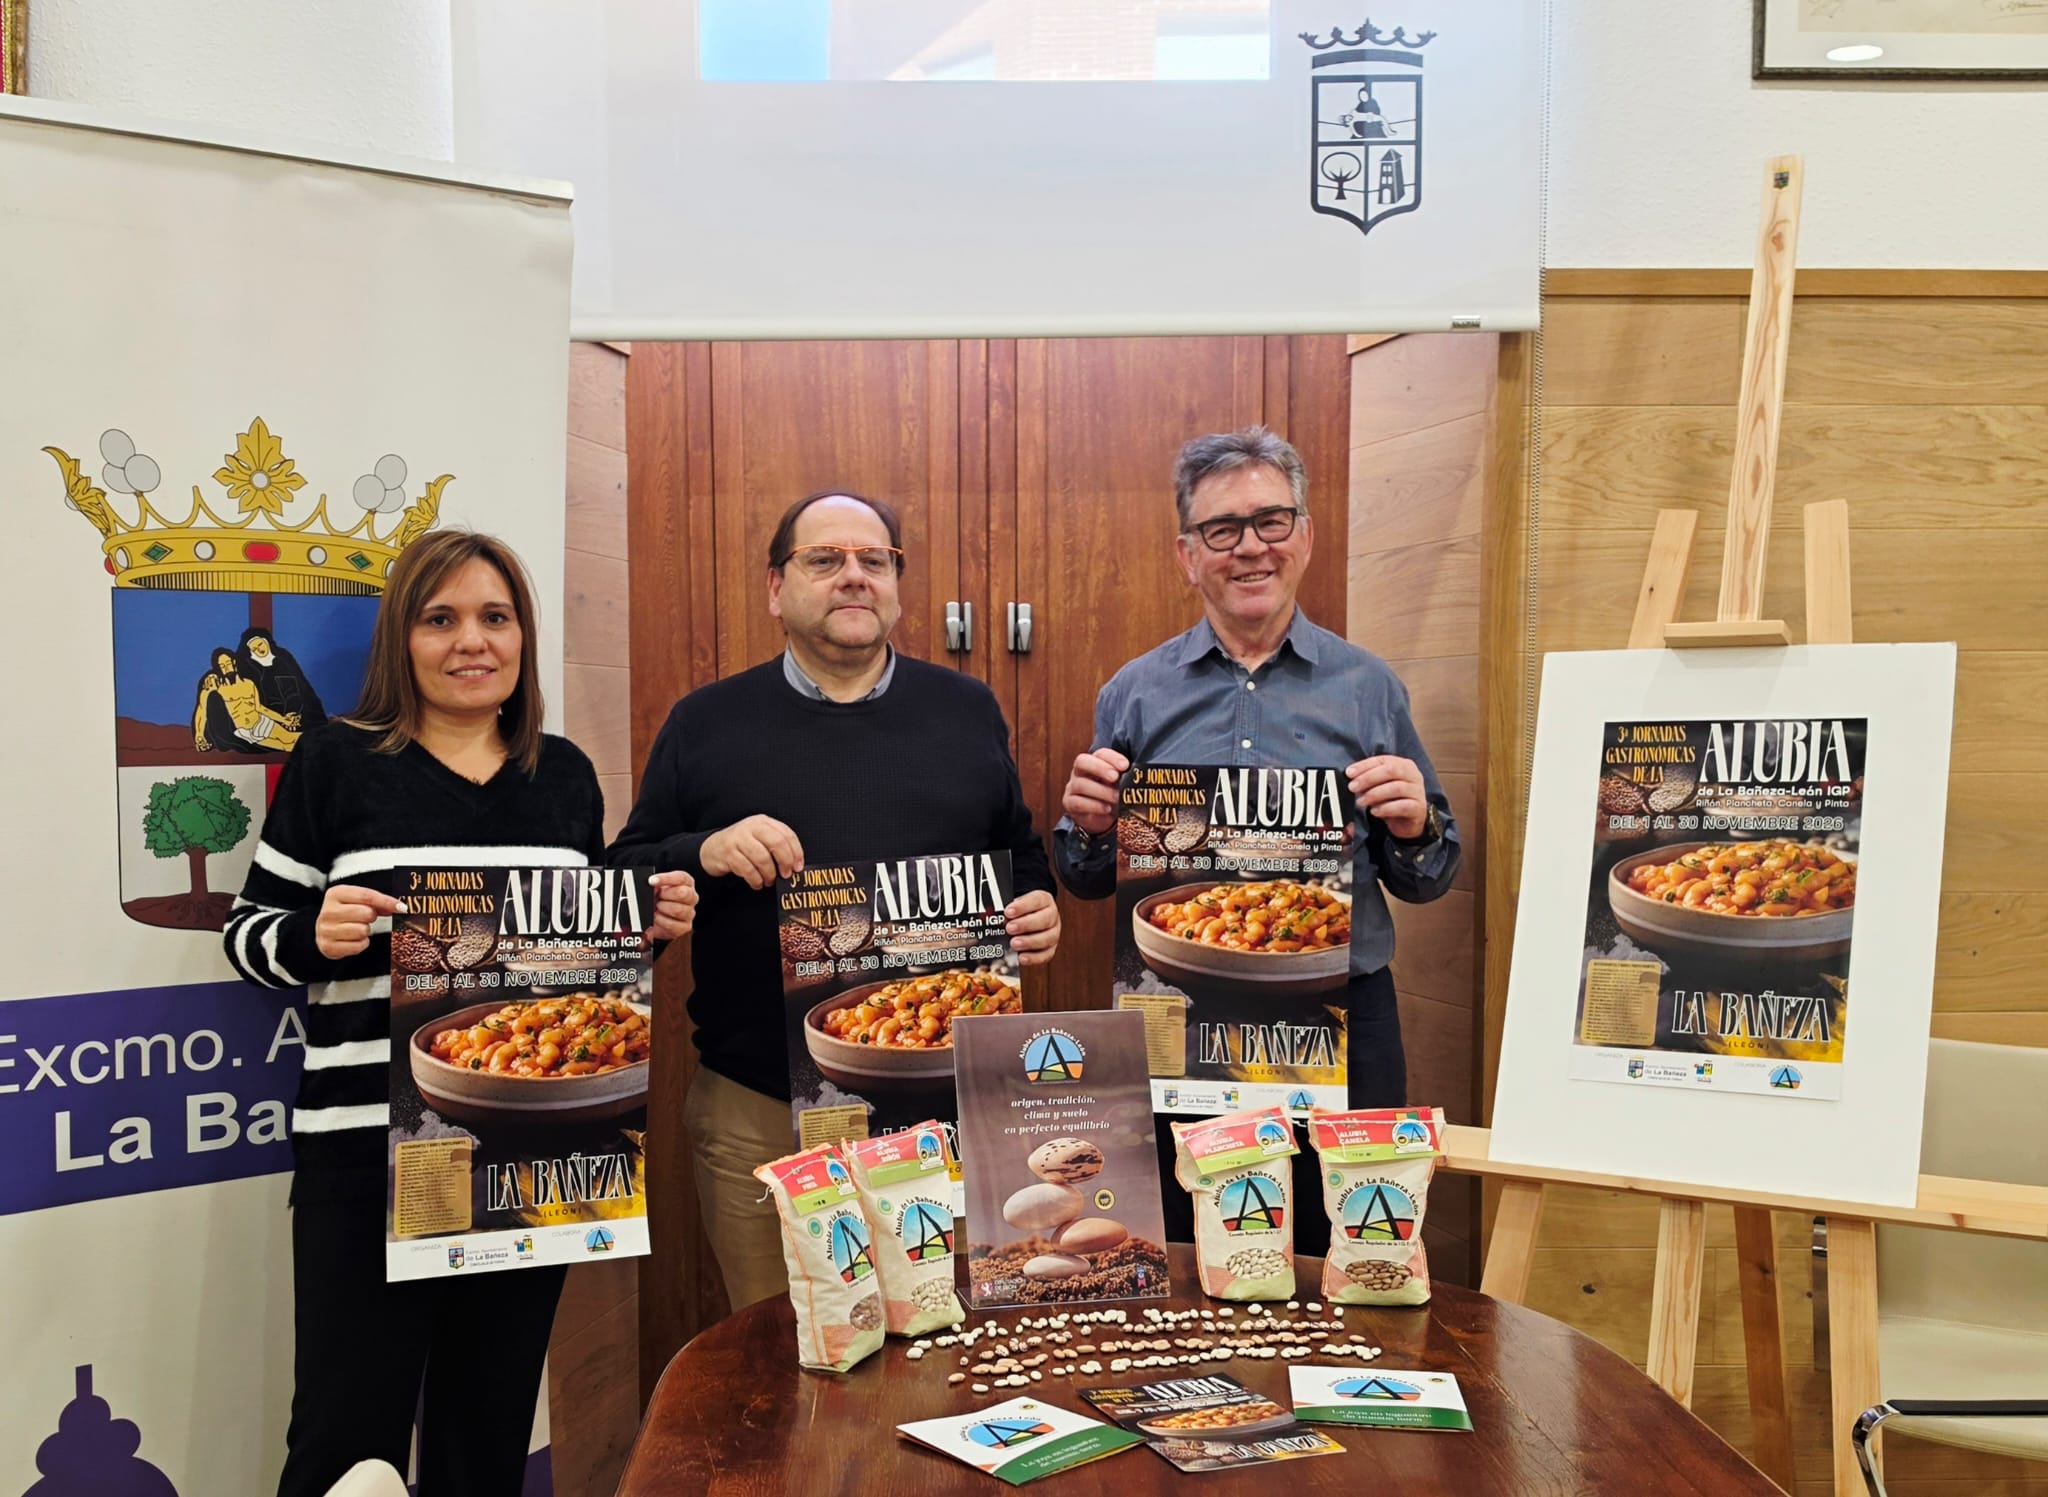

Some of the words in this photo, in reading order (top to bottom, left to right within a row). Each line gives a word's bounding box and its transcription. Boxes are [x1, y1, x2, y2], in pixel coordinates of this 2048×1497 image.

[1632, 725, 1686, 742] JORNADAS
[1606, 746, 1696, 764] GASTRONÓMICAS
[1700, 720, 1852, 782] ALUBIA
[1146, 768, 1196, 784] JORNADAS
[1633, 766, 1648, 782] DE
[1650, 766, 1664, 782] LA
[1122, 786, 1206, 806] GASTRONÓMICAS
[1210, 768, 1344, 827] ALUBIA
[1698, 786, 1714, 796] de
[1718, 786, 1733, 796] La
[1738, 785, 1822, 796] Bañeza-León
[1827, 786, 1850, 796] IGP
[1778, 800, 1812, 808] Canela
[1815, 801, 1822, 809] y
[1824, 800, 1850, 808] Pinta
[1150, 807, 1162, 824] DE
[1165, 808, 1178, 824] LA
[1610, 815, 1640, 830] DEL
[1642, 816, 1650, 829] 1
[1654, 816, 1674, 830] AL
[1678, 816, 1698, 830] 30
[1702, 815, 1798, 830] NOVIEMBRE
[1802, 816, 1844, 831] 2026
[1209, 829, 1224, 838] de
[1228, 829, 1241, 838] La
[1245, 828, 1320, 840] Bañeza-León
[1323, 831, 1344, 840] IGP
[1281, 842, 1311, 850] Canela
[1313, 844, 1319, 853] y
[1321, 844, 1342, 852] Pinta
[1130, 855, 1157, 868] DEL
[1160, 856, 1168, 868] 1
[1171, 856, 1189, 870] AL
[1193, 856, 1211, 870] 30
[1215, 856, 1300, 872] NOVIEMBRE
[1303, 858, 1338, 873] 2026
[410, 872, 422, 890] 3ª
[425, 872, 484, 890] JORNADAS
[804, 867, 855, 886] JORNADAS
[873, 854, 1004, 922] ALUBIA
[500, 869, 642, 934] ALUBIA
[782, 886, 867, 910] GASTRONÓMICAS
[811, 910, 824, 927] DE
[828, 908, 840, 926] LA
[874, 926, 888, 936] de
[892, 924, 906, 934] La
[910, 918, 982, 932] Bañeza-León
[986, 916, 1005, 925] IGP
[429, 918, 444, 936] DE
[448, 918, 462, 936] LA
[946, 931, 976, 940] Canela
[977, 931, 983, 939] y
[985, 928, 1005, 936] Pinta
[498, 940, 514, 950] de
[518, 939, 533, 950] La
[538, 936, 616, 948] Bañeza-León
[621, 936, 642, 947] IGP
[576, 951, 608, 960] Canela
[610, 952, 616, 962] y
[619, 950, 641, 958] Pinta
[796, 961, 822, 977] DEL
[827, 959, 834, 974] 1
[839, 958, 857, 972] AL
[861, 956, 879, 970] 30
[882, 948, 966, 968] NOVIEMBRE
[969, 944, 1004, 960] 2026
[406, 974, 436, 990] DEL
[441, 973, 450, 988] 1
[454, 973, 474, 988] AL
[480, 972, 500, 988] 30
[504, 969, 596, 986] NOVIEMBRE
[600, 968, 638, 984] 2026
[1672, 990, 1708, 1035] LA
[1718, 990, 1832, 1043] BAÑEZA
[266, 1007, 308, 1063] A
[1200, 1022, 1232, 1064] LA
[1240, 1020, 1336, 1067] BAÑEZA
[1024, 1110, 1050, 1120] clima
[1054, 1112, 1060, 1120] y
[1062, 1108, 1088, 1117] suelo
[55, 1111, 153, 1172] La
[186, 1091, 288, 1154] Ba
[1018, 1124, 1060, 1135] perfecto
[1062, 1121, 1110, 1132] equilibrio
[1340, 1130, 1368, 1138] ALUBIA
[487, 1163, 524, 1211] LA
[532, 1152, 633, 1206] BAÑEZA
[1337, 1188, 1353, 1213] Alubia
[485, 1252, 508, 1260] Bañeza
[1142, 1376, 1242, 1400] ALUBIA
